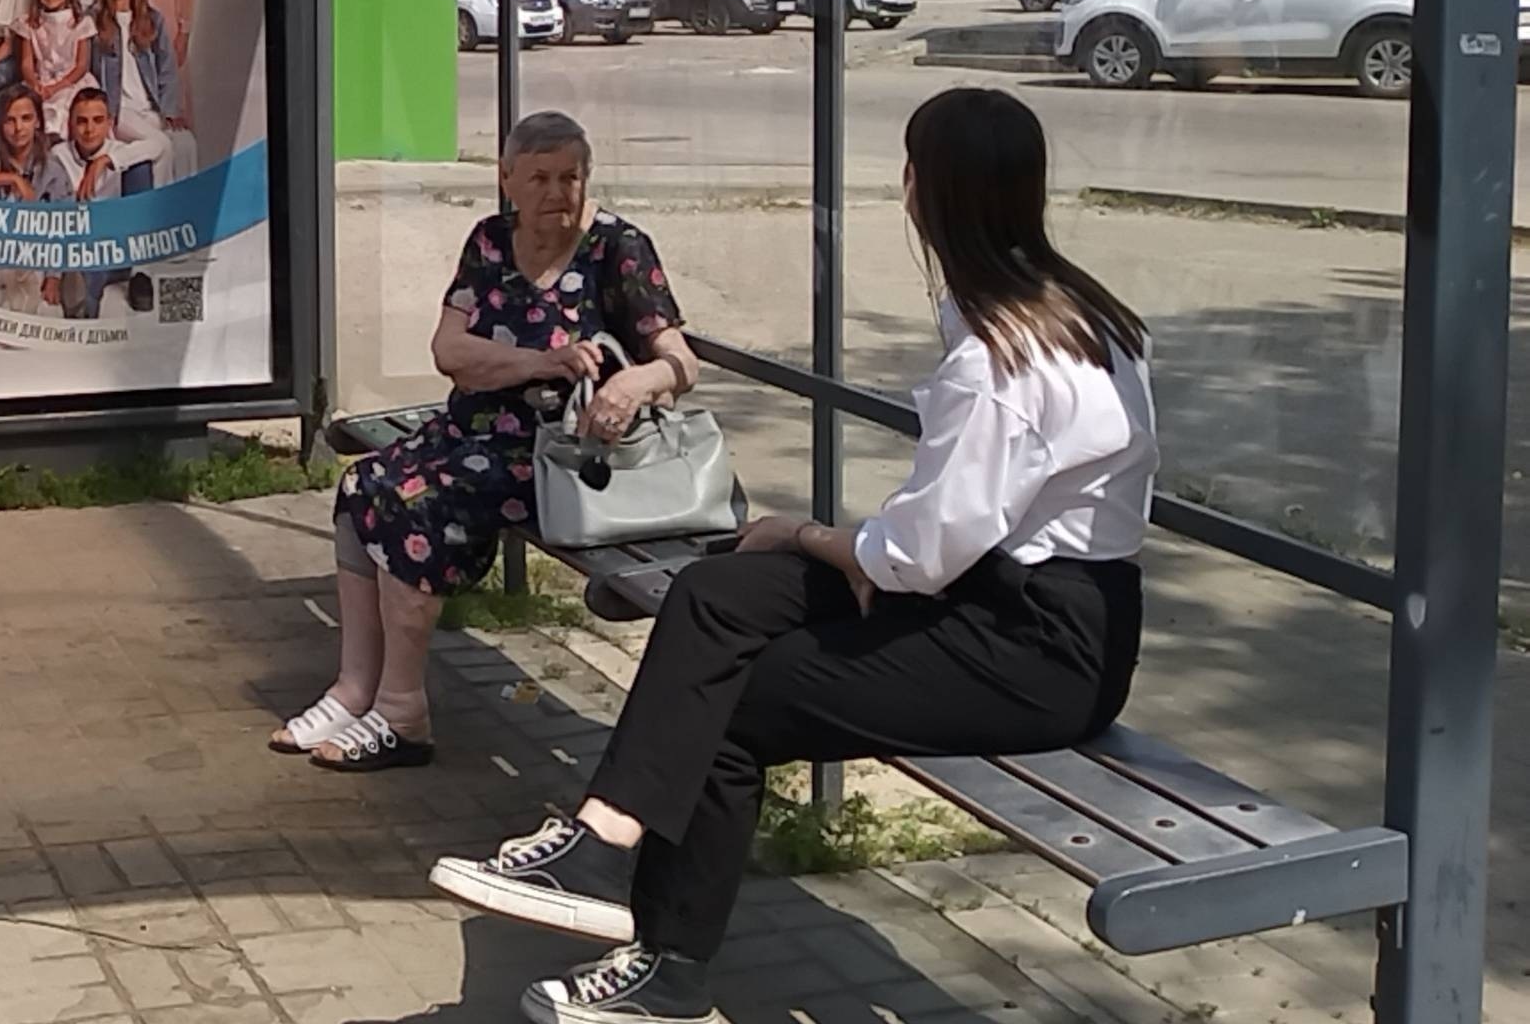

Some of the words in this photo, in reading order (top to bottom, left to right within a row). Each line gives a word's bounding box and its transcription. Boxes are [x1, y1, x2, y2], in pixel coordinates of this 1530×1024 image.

[13, 205, 91, 239] ЛЮДЕЙ
[67, 241, 125, 267] БЫТЬ
[128, 223, 197, 262] МНОГО
[19, 323, 41, 339] ДЛЯ
[43, 325, 76, 343] СЕМЕЙ
[85, 329, 128, 345] ДЕТЬМИ
